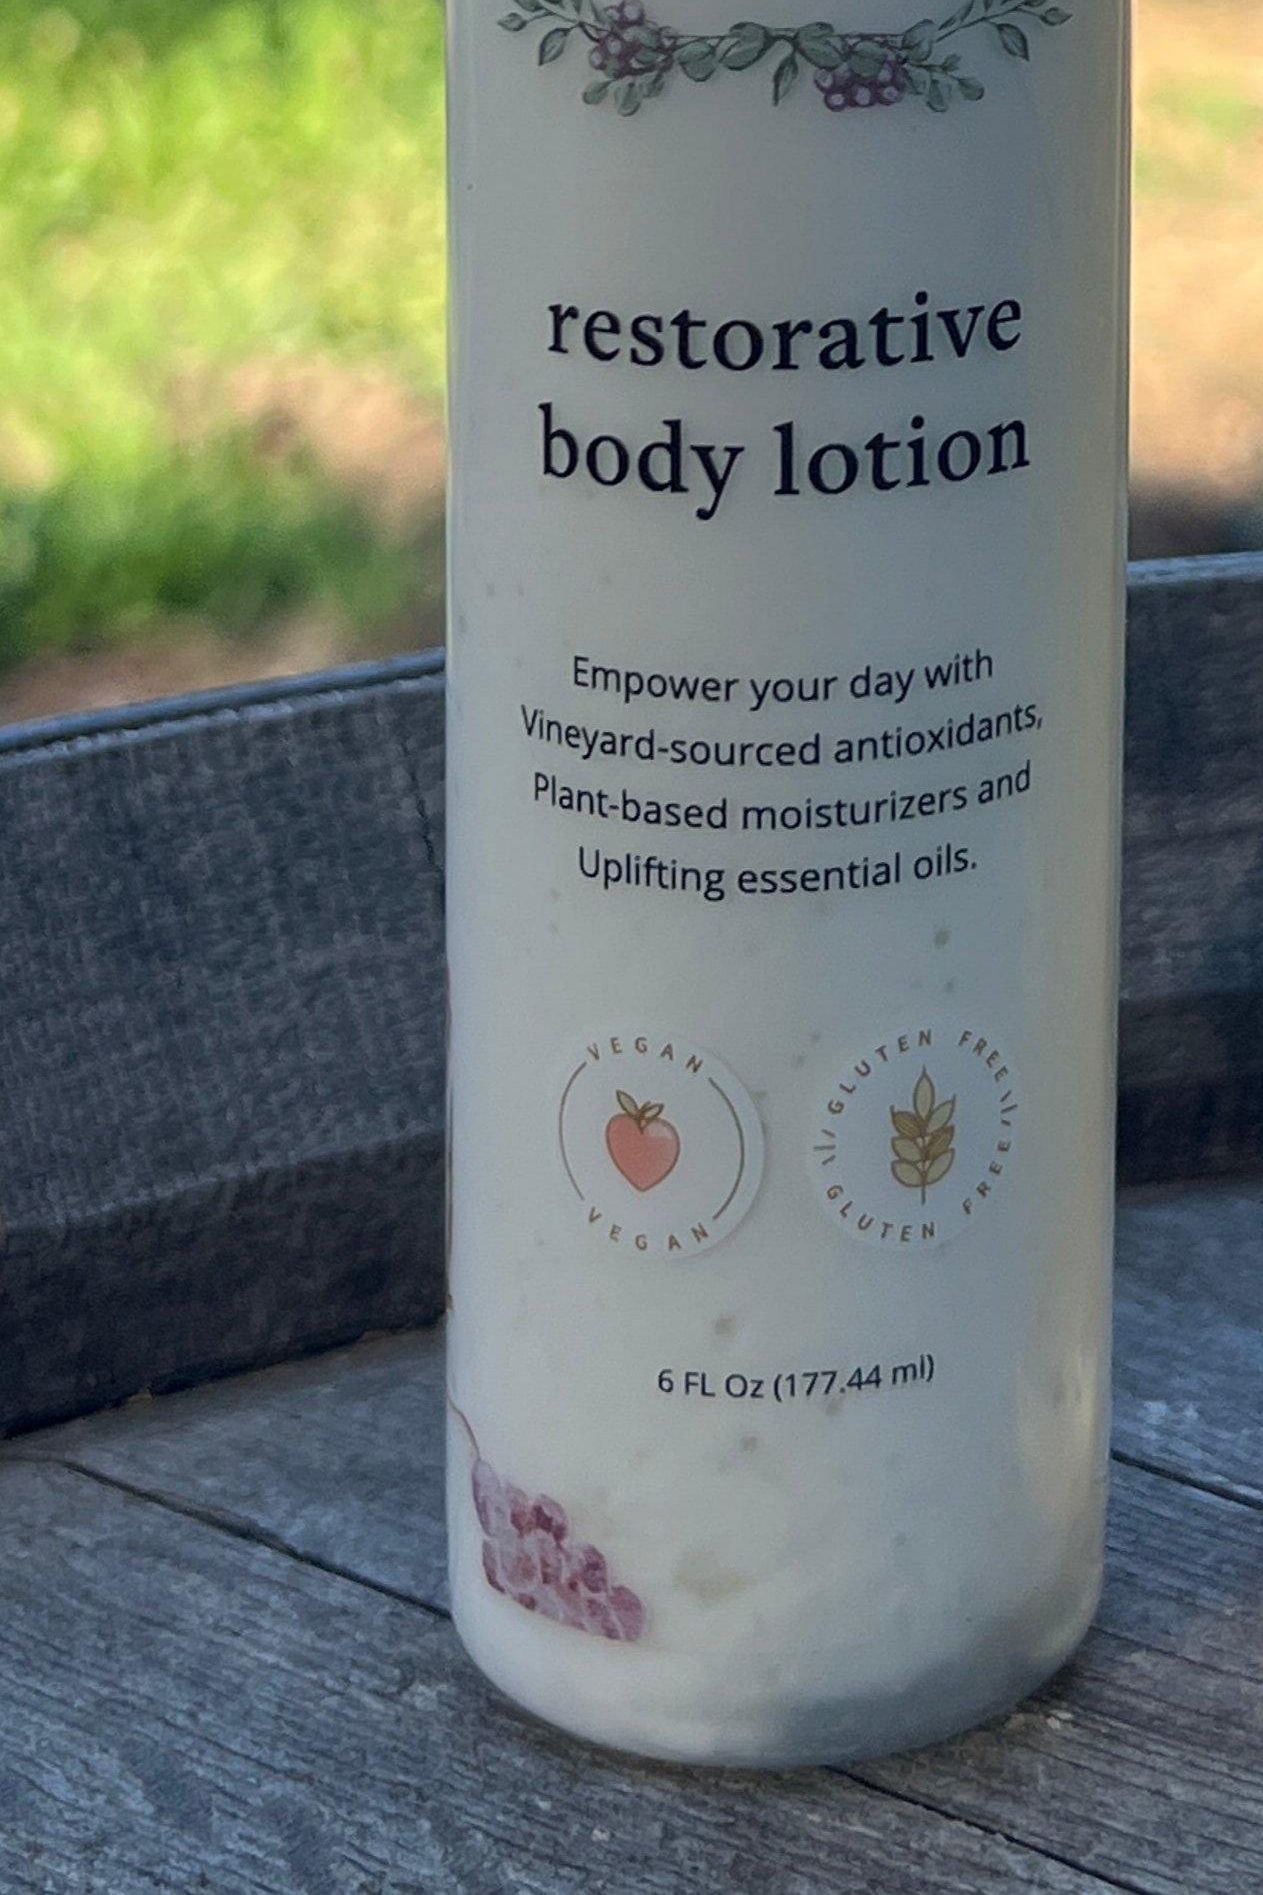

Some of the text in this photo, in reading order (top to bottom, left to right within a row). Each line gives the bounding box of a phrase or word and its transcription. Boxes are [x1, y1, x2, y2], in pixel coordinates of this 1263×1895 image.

[548, 291, 1022, 372] restorative
[538, 402, 1030, 520] body lotion
[572, 648, 993, 712] Empower your day with
[521, 701, 1043, 766] Vineyard-sourced antioxidants,
[533, 759, 1031, 830] Plant-based moisturizers and
[578, 842, 978, 901] Uplifting essential oils.
[587, 1037, 703, 1075] VEGAN
[828, 1029, 1009, 1115] GLUTEN FREE
[827, 1140, 1012, 1242] GLUTEN FREE
[589, 1206, 708, 1252] VEGAN
[658, 1354, 935, 1402] 6 FL Oz (177.44 ml)
